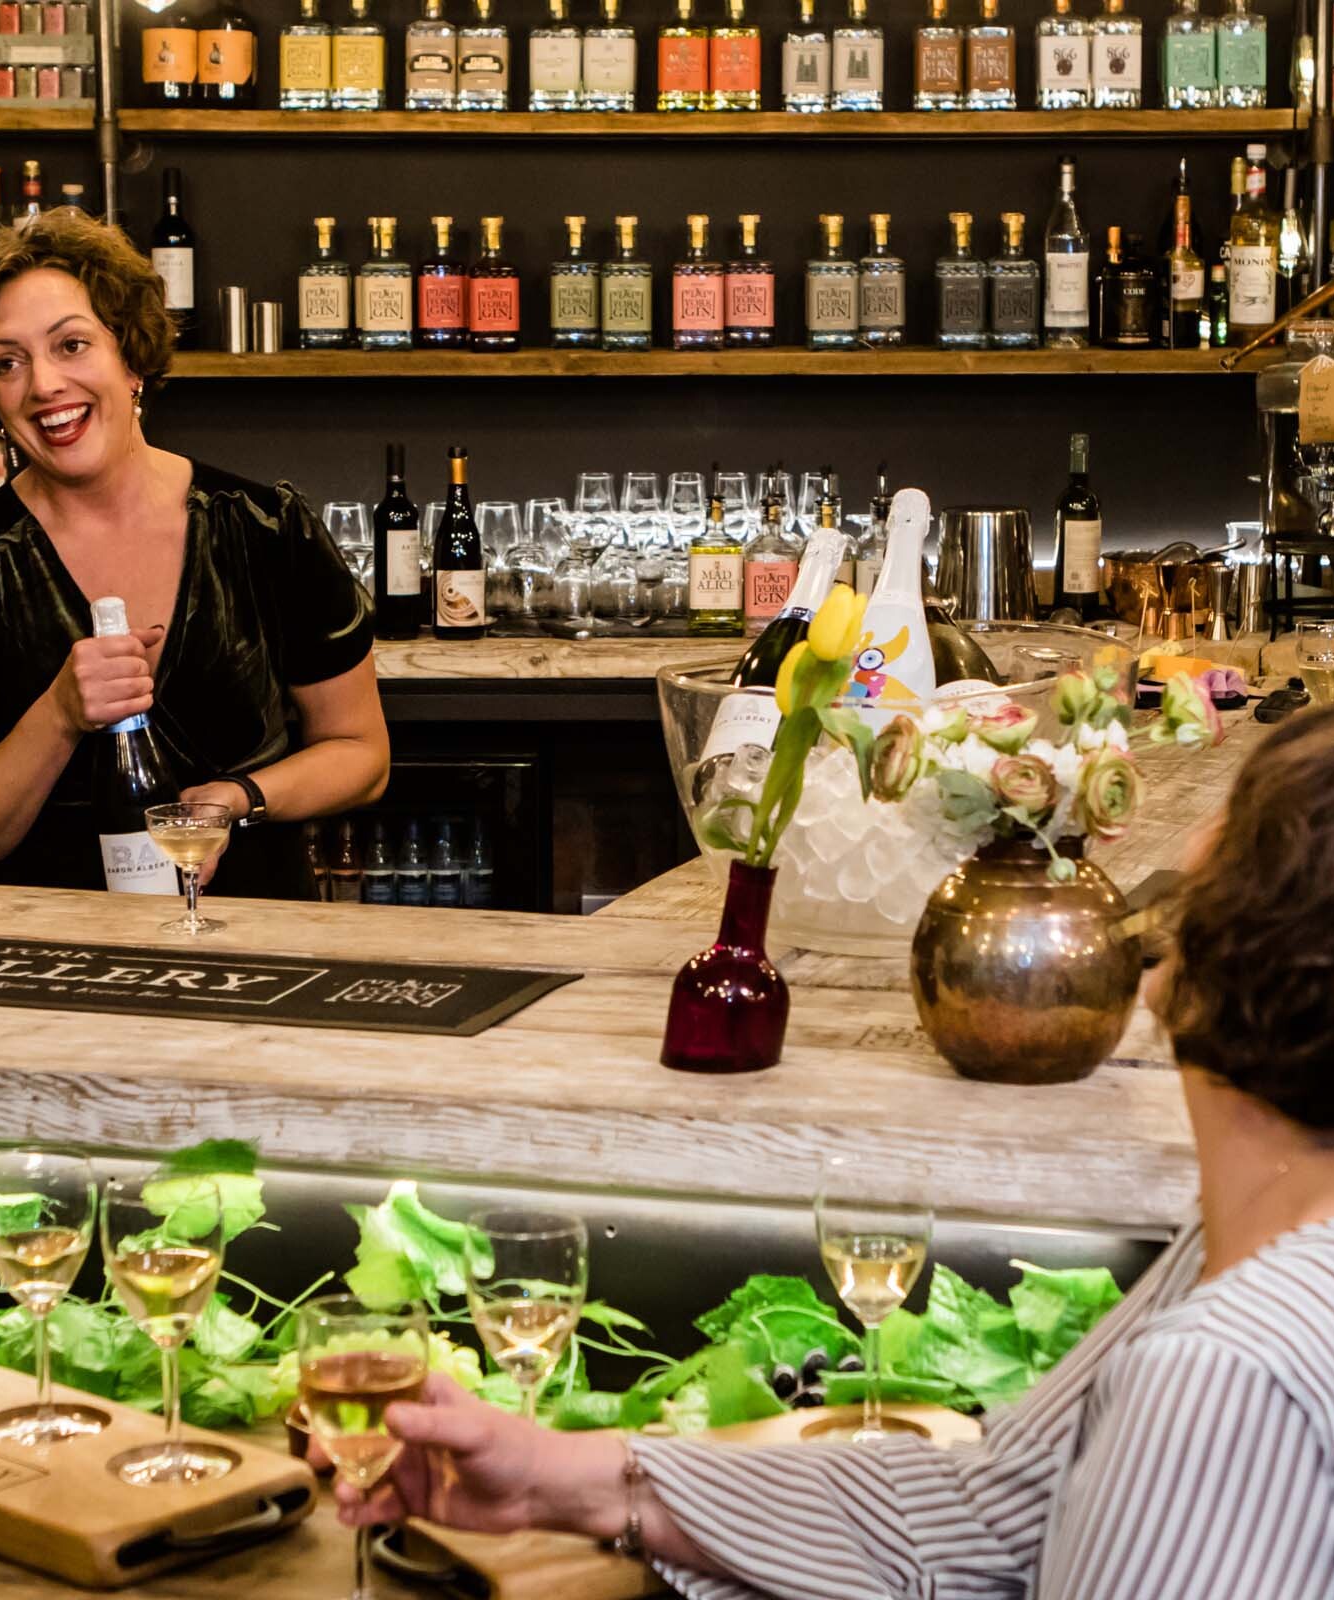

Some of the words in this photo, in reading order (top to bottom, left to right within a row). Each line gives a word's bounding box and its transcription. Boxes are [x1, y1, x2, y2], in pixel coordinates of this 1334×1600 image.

[1233, 256, 1271, 266] MONIN
[1122, 287, 1146, 295] CODE
[309, 305, 335, 315] GIN
[372, 308, 399, 318] GIN
[429, 305, 456, 315] GIN
[481, 308, 509, 318] GIN
[562, 306, 589, 315] GIN
[612, 308, 639, 318] GIN
[685, 307, 711, 317] GIN
[736, 304, 763, 313] GIN
[820, 307, 847, 317] GIN
[867, 303, 894, 313] GIN
[702, 571, 732, 580] MAD
[697, 580, 735, 590] ALICE
[757, 585, 786, 593] YORK
[757, 594, 786, 603] GIN
[107, 866, 133, 874] BARON
[136, 860, 170, 872] ALBERT
